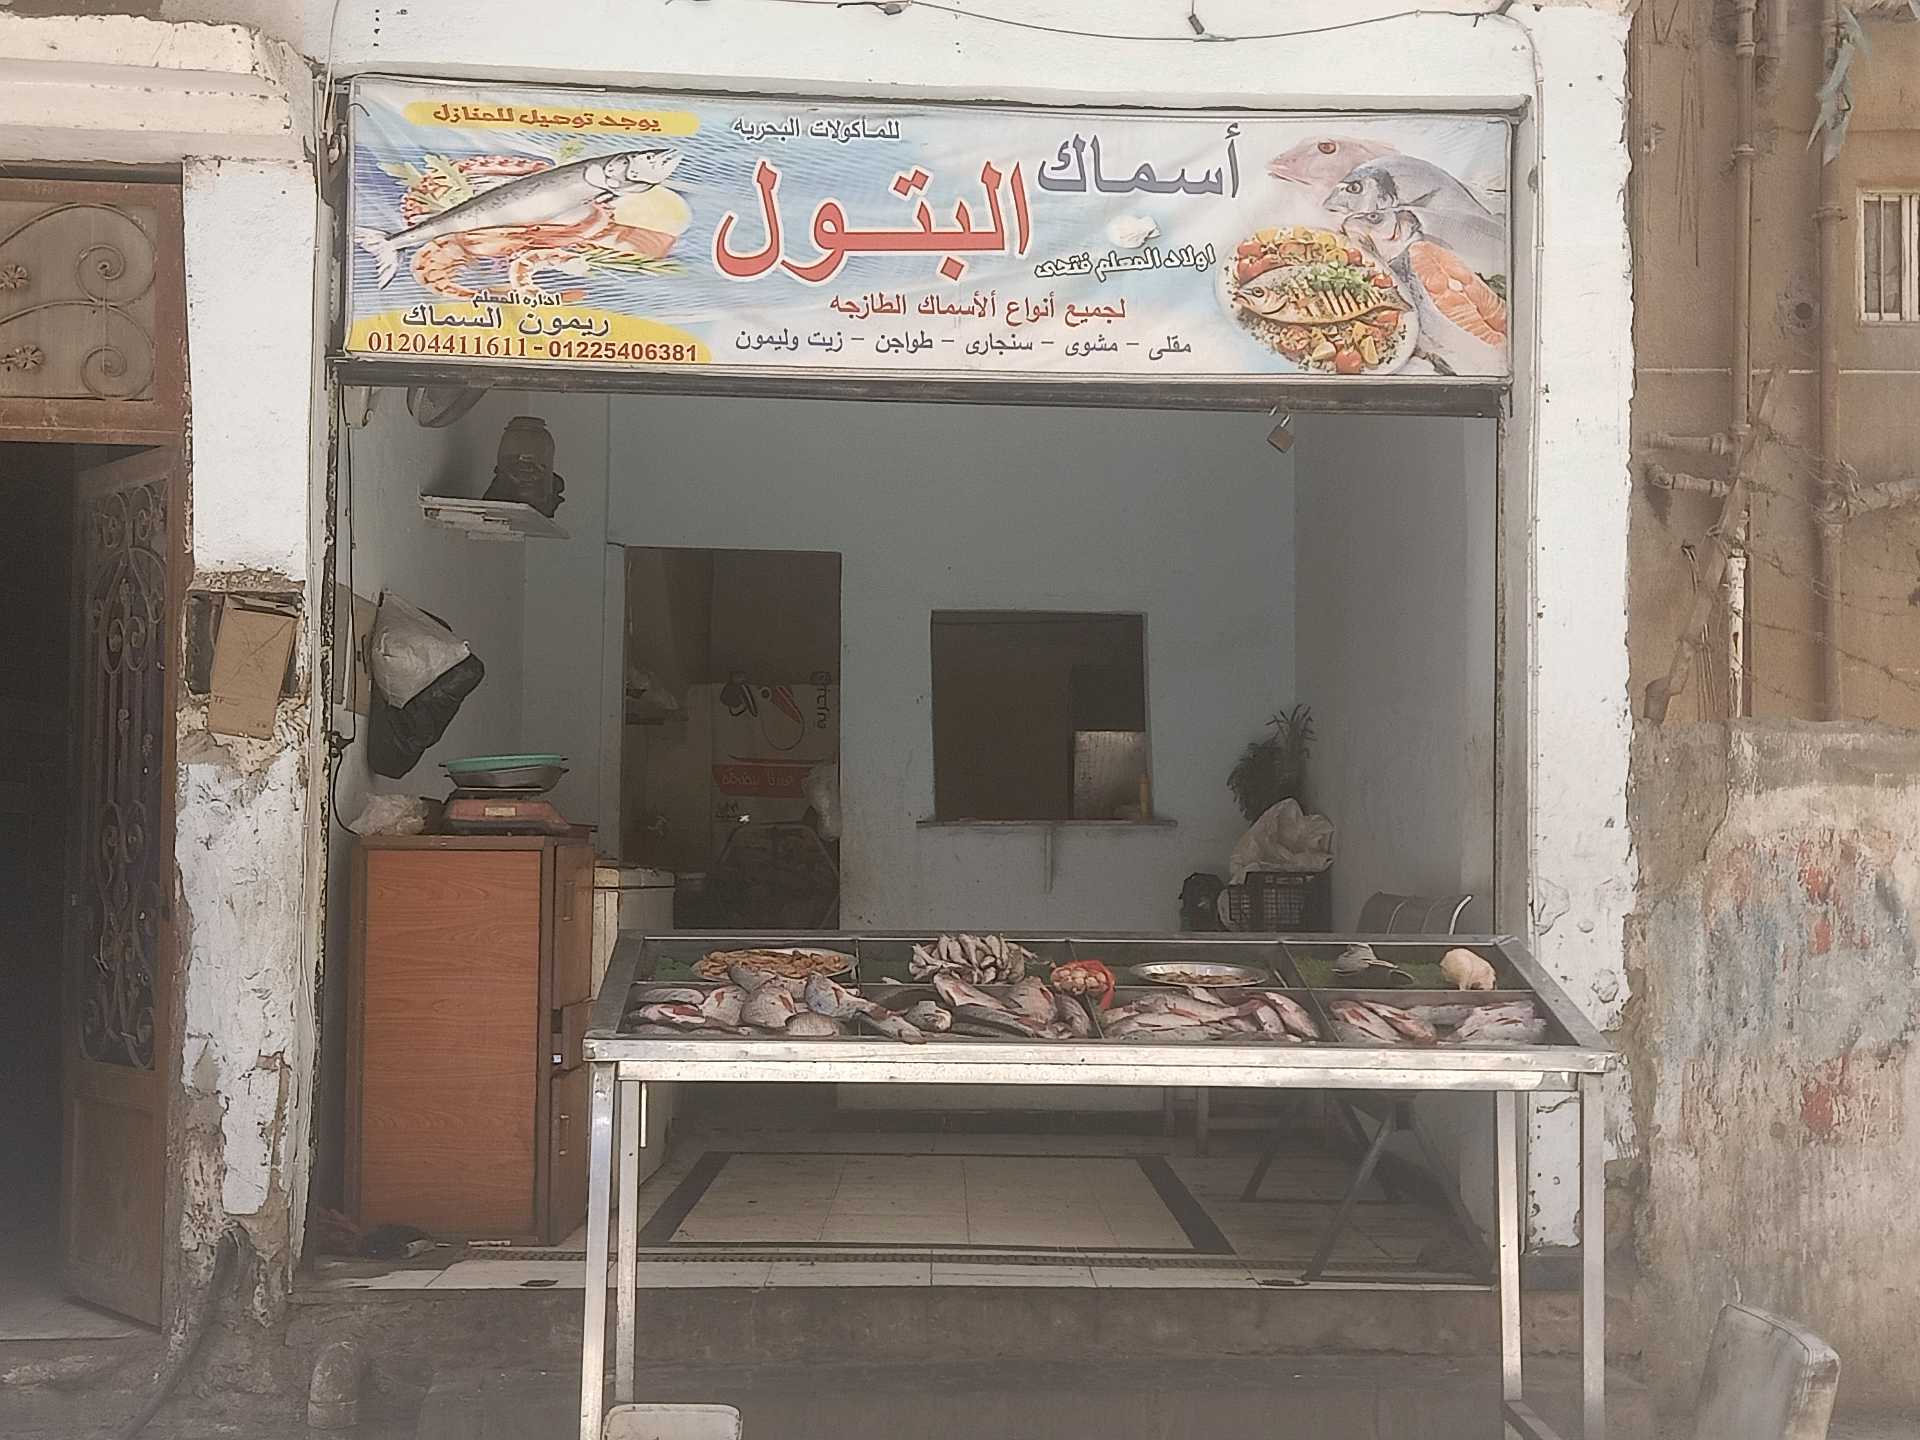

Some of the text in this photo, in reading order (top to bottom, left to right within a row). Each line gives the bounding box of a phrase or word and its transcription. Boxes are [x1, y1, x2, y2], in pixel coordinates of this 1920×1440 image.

[433, 103, 662, 132] يوجد توصيل للمنازل
[733, 118, 800, 141] البحريه
[1038, 122, 1241, 198] أسماك
[716, 161, 1029, 282] البتول
[1095, 247, 1162, 283] المعلم
[1164, 243, 1217, 272] اولاد
[402, 306, 609, 336] ريمون السماك
[830, 293, 907, 320] الطازجه
[1005, 291, 1055, 326] أنواع
[1064, 298, 1126, 327] لجميع
[368, 332, 528, 358] 01204411611
[549, 341, 698, 362] 01225406381
[735, 328, 799, 351] وليمون
[807, 332, 843, 352] زيت
[875, 331, 933, 353] طواجن
[965, 333, 1033, 355] سنجارى
[1065, 333, 1118, 356] مشوى
[1149, 335, 1192, 360] مقلى
